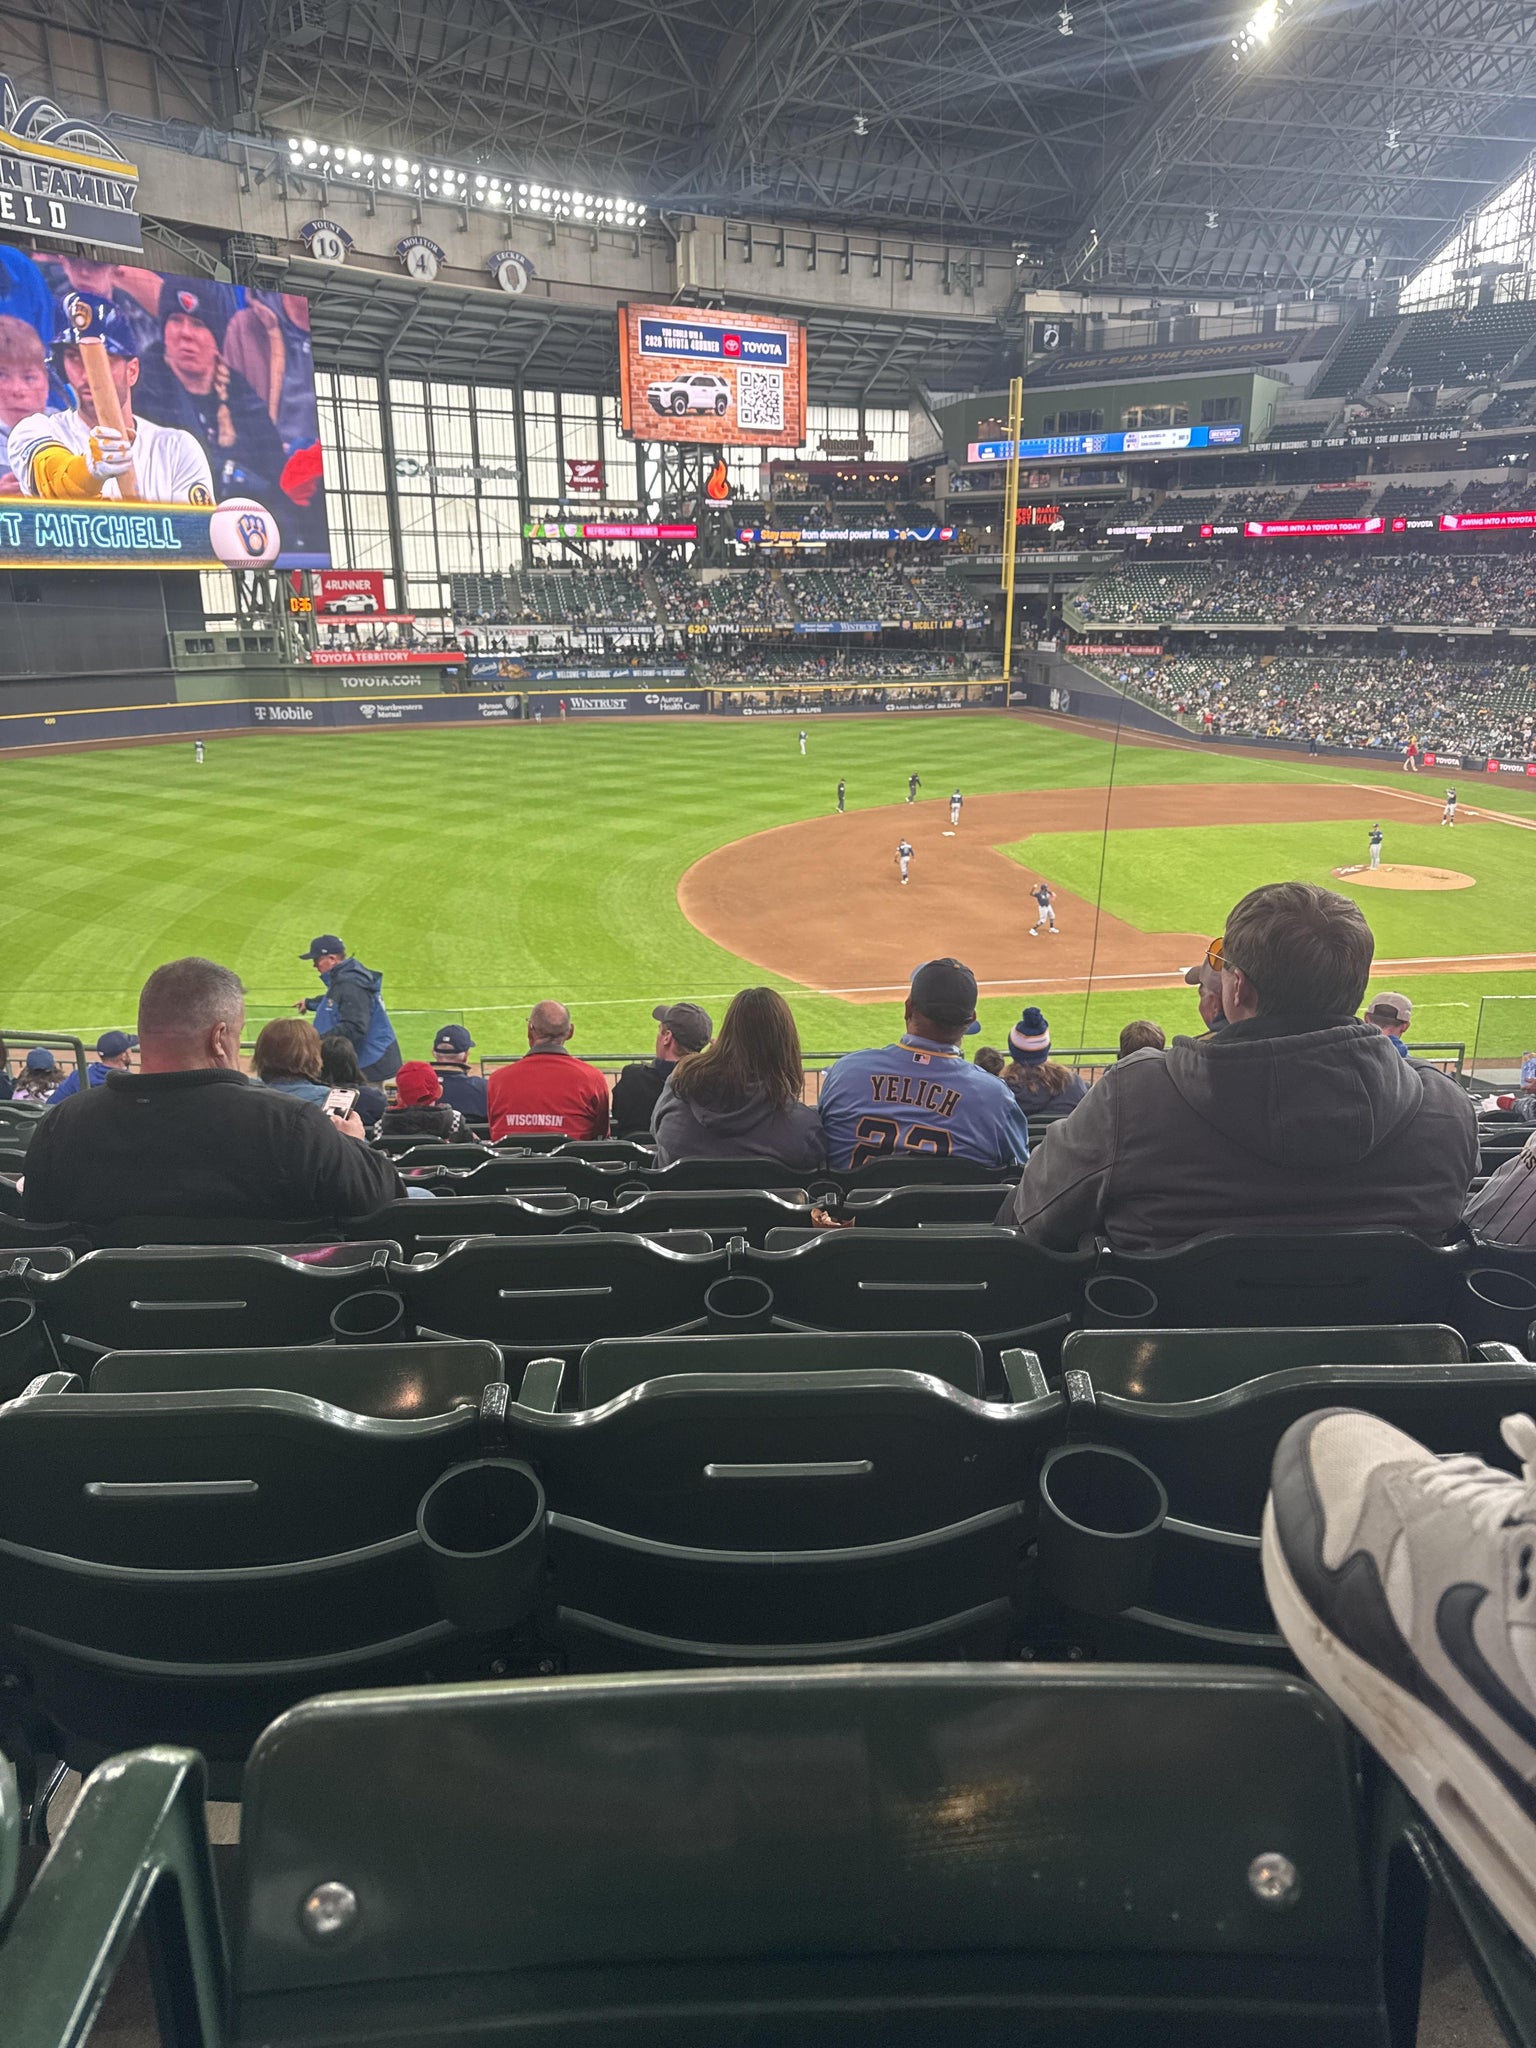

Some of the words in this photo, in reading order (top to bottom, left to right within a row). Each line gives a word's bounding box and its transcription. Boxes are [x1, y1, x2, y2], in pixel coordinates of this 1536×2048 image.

[31, 164, 138, 212] FAMILY
[0, 191, 66, 230] ELD
[311, 219, 341, 235] YOUNT
[316, 236, 341, 259] 19
[402, 237, 440, 254] MOLITOR
[415, 253, 427, 274] 4
[495, 251, 526, 265] UECKER
[664, 337, 689, 350] TOYOTA
[742, 341, 782, 356] TOYOTA
[1066, 358, 1106, 369] MUST
[1109, 356, 1128, 364] BE
[1131, 354, 1147, 362] IN
[1151, 351, 1180, 360] THE
[1182, 346, 1237, 357] FRONT
[1239, 341, 1285, 351] ROW!
[816, 434, 874, 452] Johnsonville
[1407, 520, 1433, 529] TOYOTA
[1461, 518, 1485, 526] SWING
[1485, 517, 1500, 525] INTO
[1507, 515, 1532, 524] TOYOTA
[35, 513, 182, 549] MITCHELL
[1266, 525, 1288, 533] SWING
[1312, 523, 1337, 531] TOYOTA
[1338, 523, 1361, 531] TODAY
[760, 530, 779, 541] Stay
[780, 531, 801, 541] away
[802, 529, 818, 540] from
[820, 529, 849, 540] downed
[850, 530, 872, 541] power
[873, 529, 889, 539] lines
[325, 580, 371, 591] 4RUNNER
[687, 624, 708, 634] 620
[708, 624, 740, 634] WTMJ
[912, 620, 938, 630] NICOLET
[940, 620, 953, 629] LAW
[315, 653, 354, 663] TOYOTA
[356, 652, 410, 662] TERRITORY
[556, 670, 580, 678] WELCOME
[341, 675, 421, 687] TOYOTA.COM
[570, 697, 628, 709] WINTRUST
[660, 695, 684, 703] Aurora
[376, 703, 423, 711] Northwestern
[478, 703, 503, 711] Johnson
[684, 702, 700, 710] Care
[269, 706, 314, 721] Mobile
[377, 710, 402, 718] Mutual
[482, 709, 508, 717] Controls
[1435, 757, 1460, 766] TOYOTA
[1500, 763, 1524, 773] TOYOTA
[870, 1074, 961, 1119] YELICH
[506, 1114, 564, 1127] WISCONSIN
